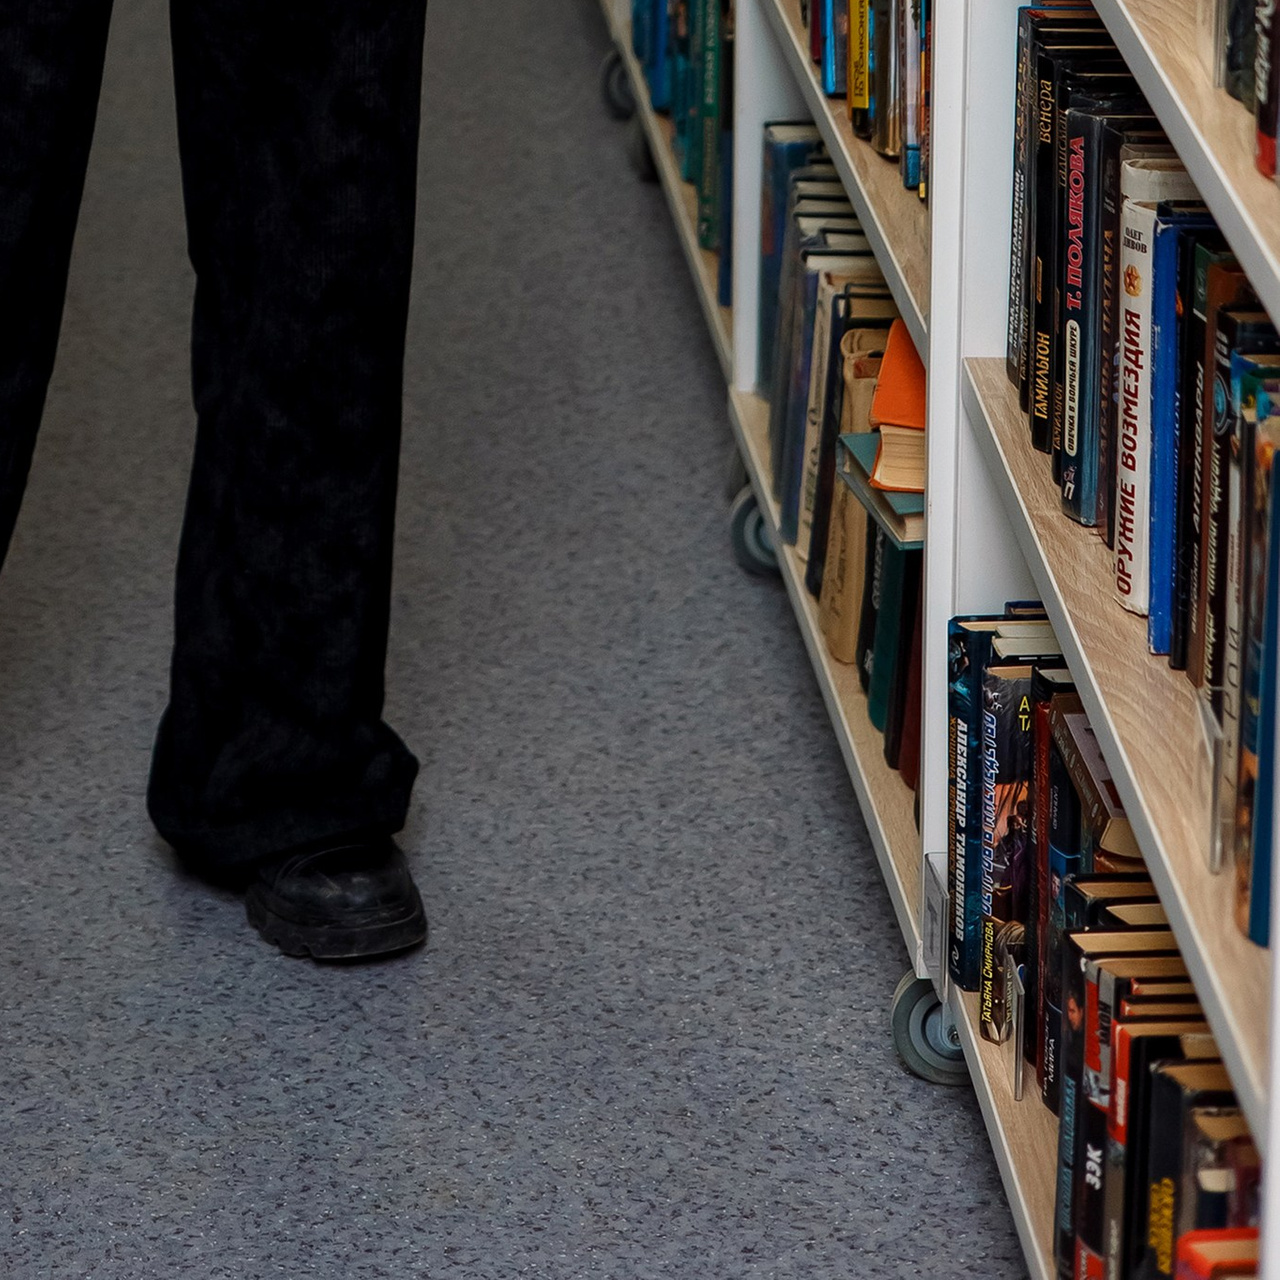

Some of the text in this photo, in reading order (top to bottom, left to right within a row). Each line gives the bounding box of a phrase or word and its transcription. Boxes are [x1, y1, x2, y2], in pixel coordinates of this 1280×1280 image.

[1011, 168, 1021, 253] ГАЛАКТИКИ,
[1066, 135, 1085, 311] Т. ПОЛЯКОВА
[1010, 254, 1018, 301] ГЕРОЙ
[1033, 331, 1050, 420] ГАМИЛЬТОН
[1116, 309, 1142, 596] ОРУЖИЕ ВОЗМЕЗДИЯ
[1193, 359, 1205, 534] АНТИКВАРЫ
[953, 717, 967, 942] АЛЕКСАНДР ТАМОНИКОВ
[981, 921, 994, 1023] ТАТЬЯНА СМИРНОВА
[1086, 1143, 1103, 1191] ЗЭК
